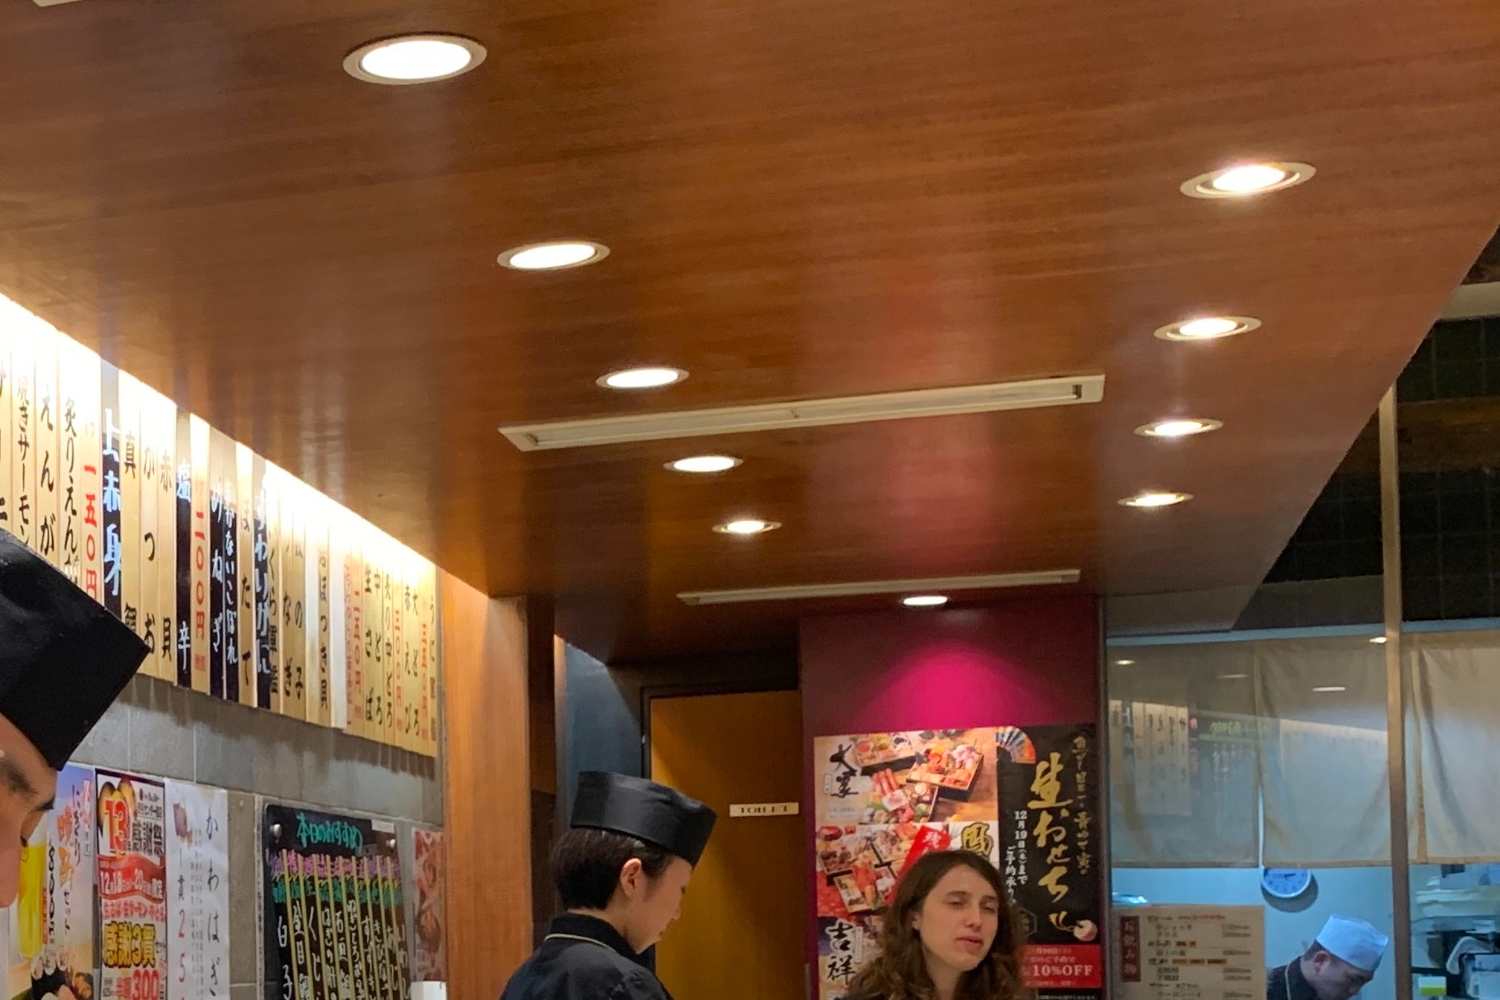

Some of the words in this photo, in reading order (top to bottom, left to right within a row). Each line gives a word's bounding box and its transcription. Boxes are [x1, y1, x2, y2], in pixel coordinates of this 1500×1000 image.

[102, 408, 121, 597] 上赤身
[158, 449, 173, 663] 赤貝
[1032, 964, 1094, 977] 10%OFF
